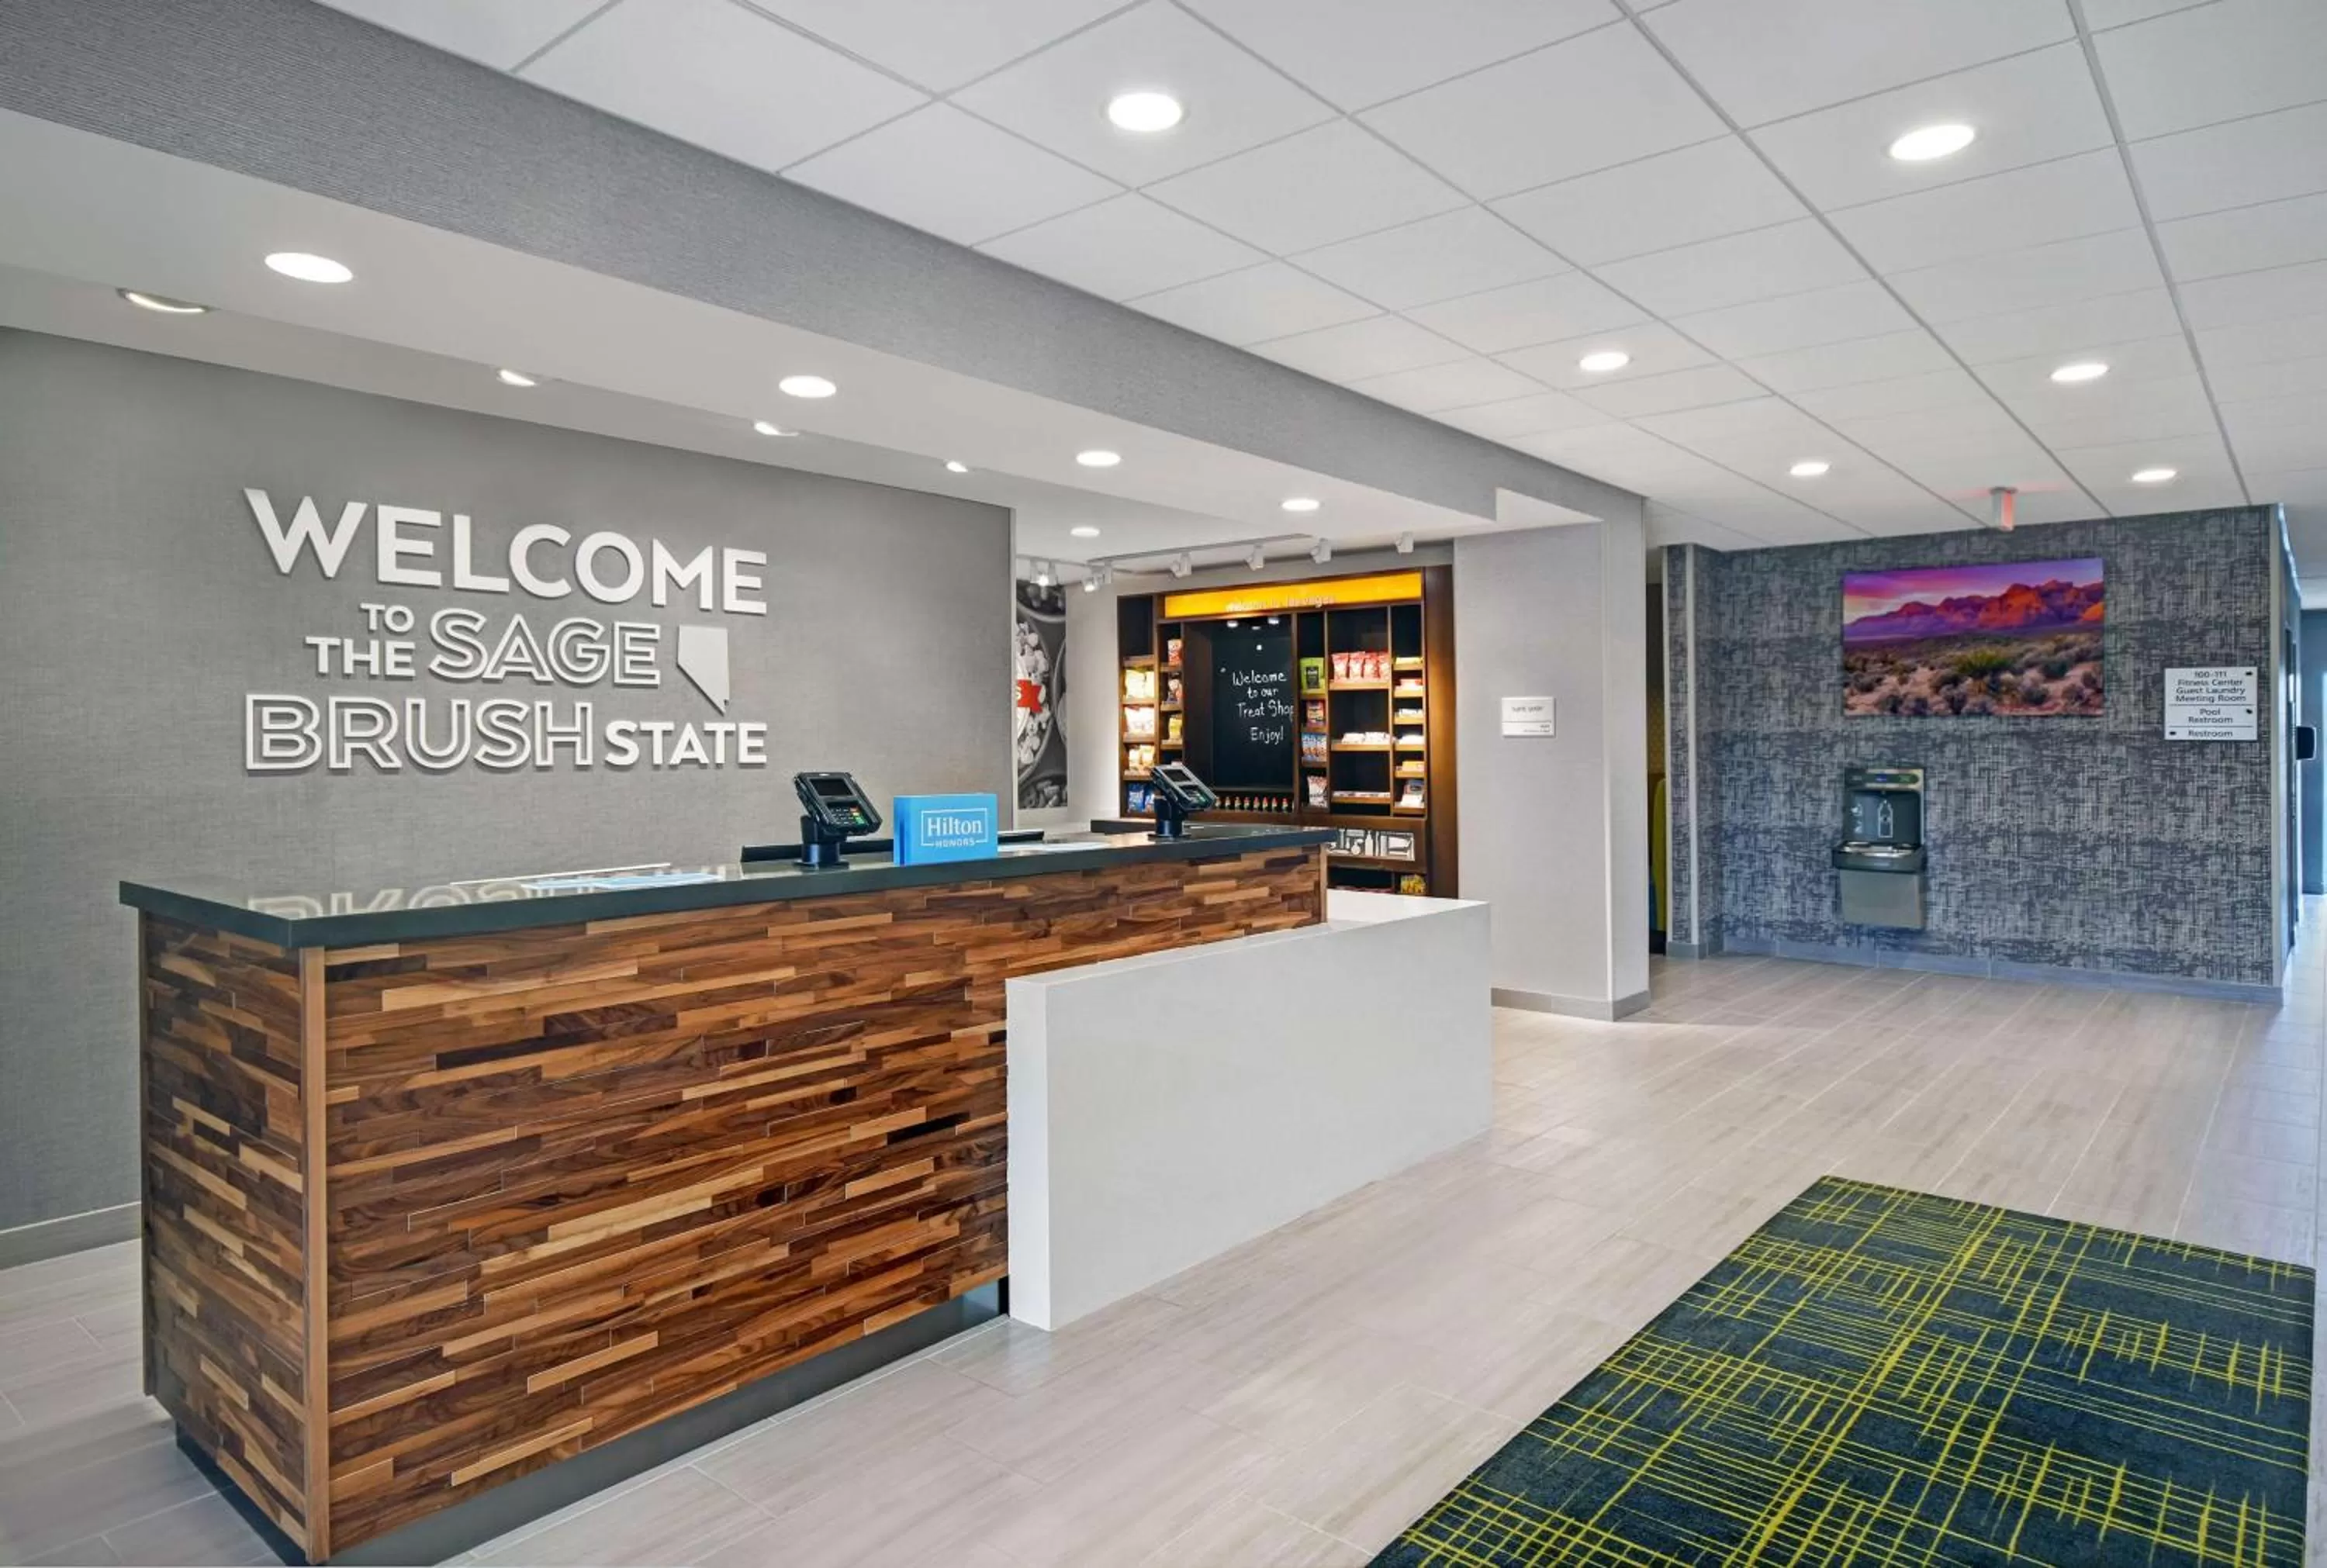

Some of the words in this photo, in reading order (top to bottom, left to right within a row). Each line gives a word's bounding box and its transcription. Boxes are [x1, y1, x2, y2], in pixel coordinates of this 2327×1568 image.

[243, 488, 768, 615] WELCOME
[360, 603, 415, 633] TO
[306, 636, 416, 679] THE
[429, 608, 661, 688] SAGE
[1232, 670, 1287, 686] Welcome
[1247, 687, 1258, 699] to
[1260, 688, 1278, 697] our
[1236, 702, 1265, 718] Treat
[245, 693, 593, 771] BRUSH
[604, 720, 768, 766] STATE
[1250, 725, 1284, 744] Enjoy!
[928, 816, 983, 837] Hilton
[935, 838, 975, 848] HONORS
